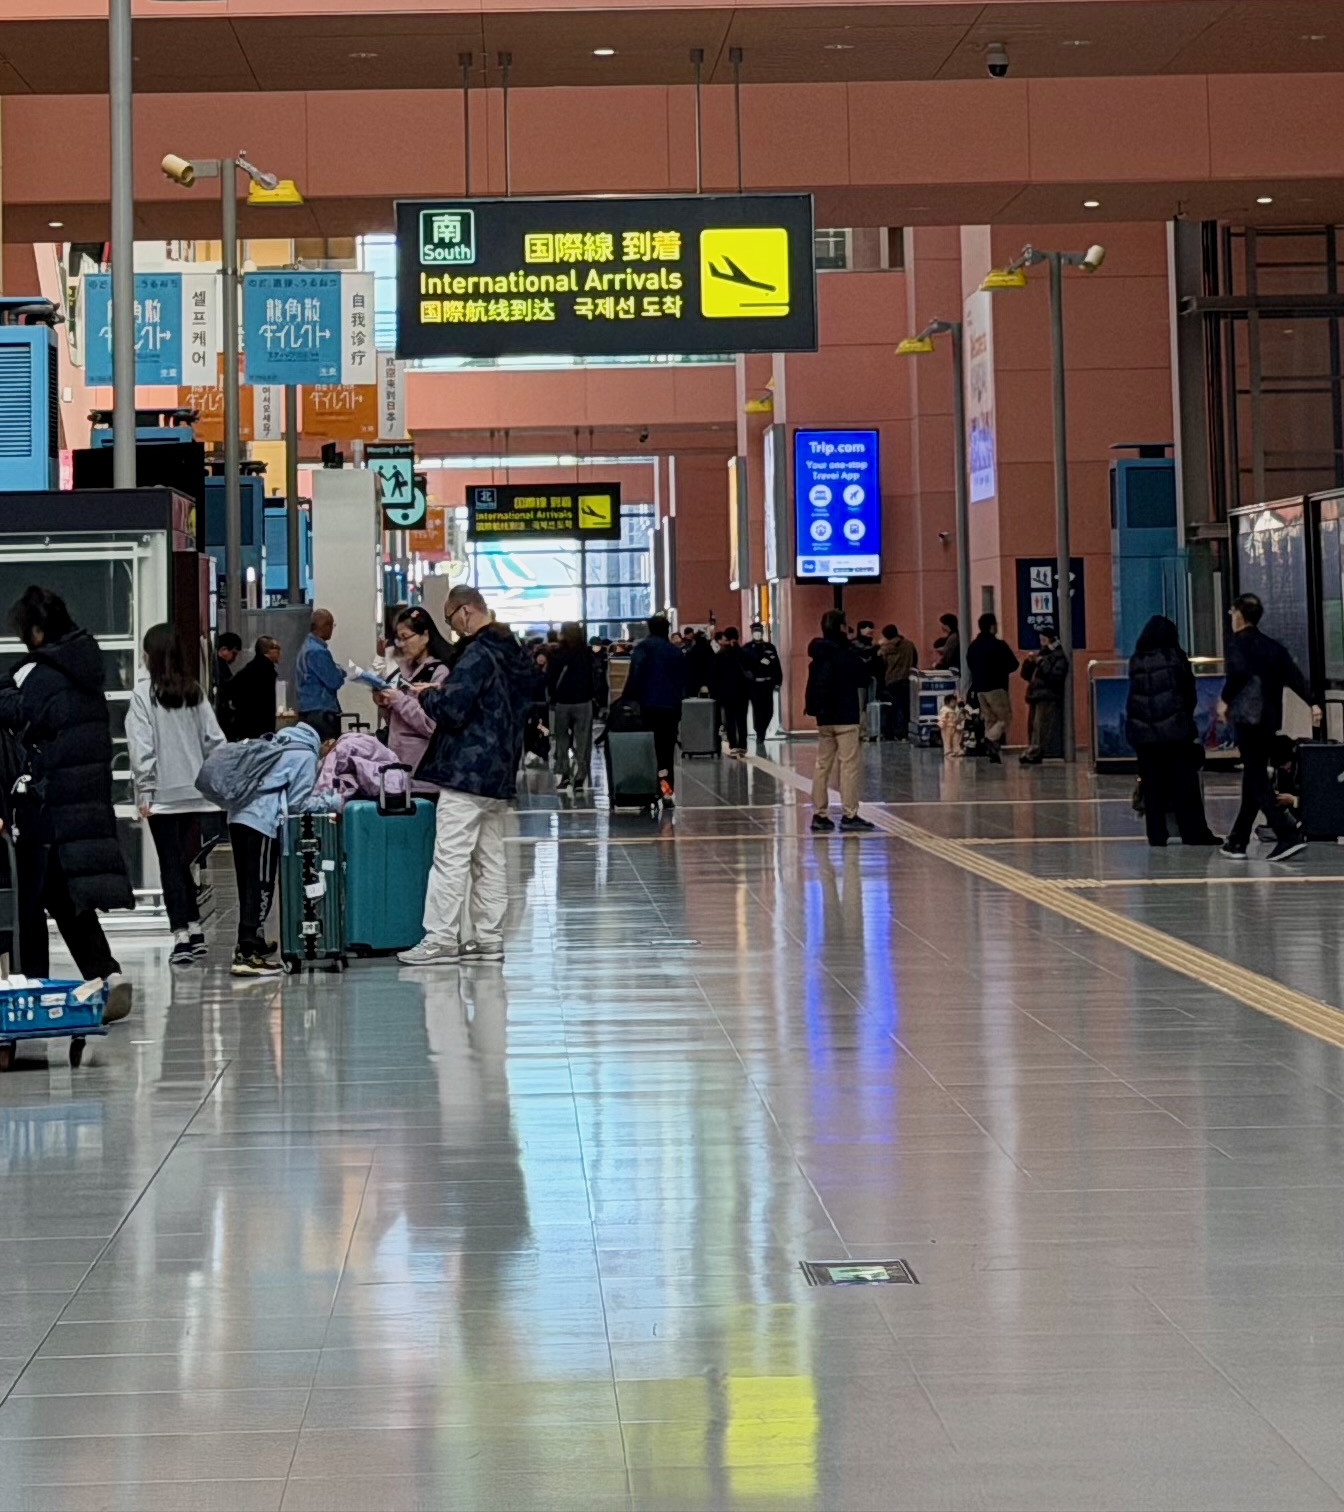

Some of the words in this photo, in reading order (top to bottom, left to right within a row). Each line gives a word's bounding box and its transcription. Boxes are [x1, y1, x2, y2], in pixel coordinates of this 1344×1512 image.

[432, 215, 462, 243] 南
[424, 244, 472, 261] South
[524, 232, 614, 264] 国際線
[622, 231, 682, 262] 到着
[420, 269, 578, 295] International
[584, 268, 683, 291] Arrivals
[266, 297, 320, 322] 龍角散
[573, 296, 636, 320] 국제선
[641, 295, 683, 319] 도착
[258, 325, 331, 351] ダイレクト
[808, 441, 866, 456] Trip.com
